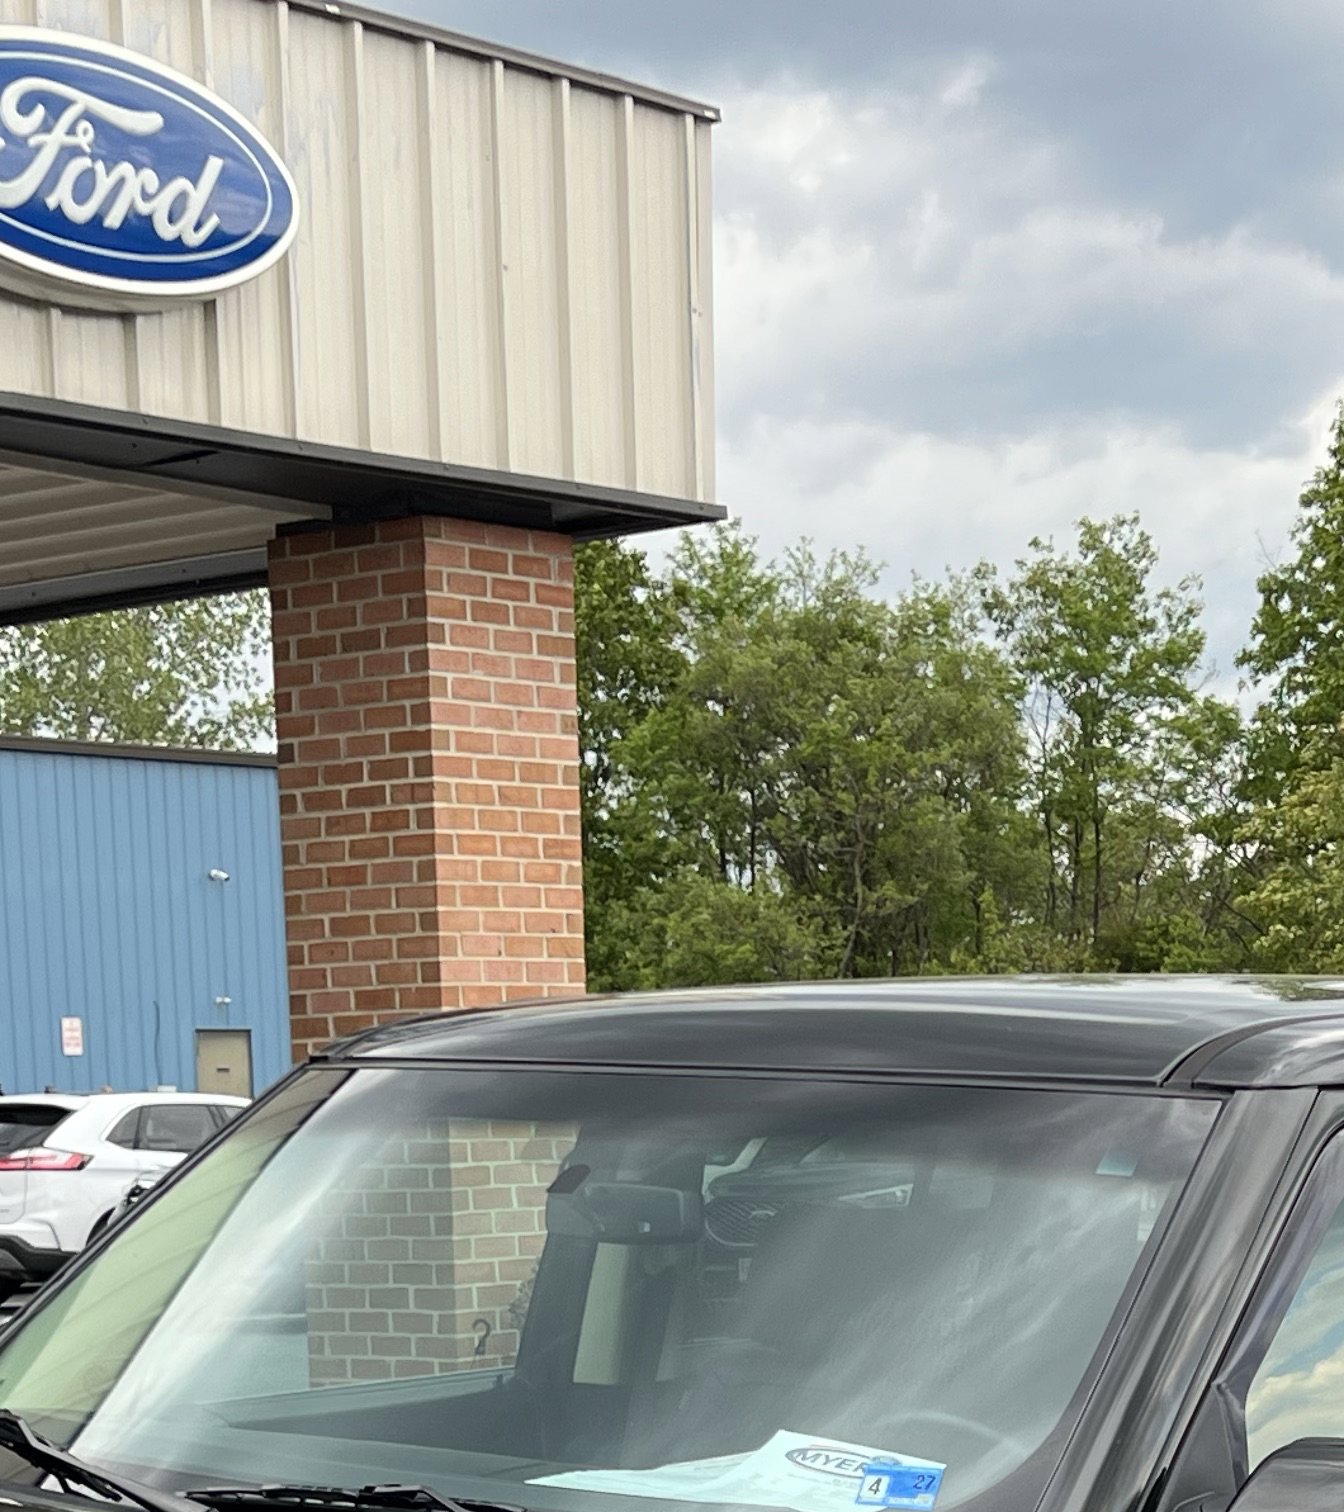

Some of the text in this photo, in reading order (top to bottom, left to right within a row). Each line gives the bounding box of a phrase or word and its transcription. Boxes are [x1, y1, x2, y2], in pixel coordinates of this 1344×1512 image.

[795, 1450, 870, 1473] MYER
[867, 1477, 883, 1495] 4
[912, 1474, 937, 1490] 27
